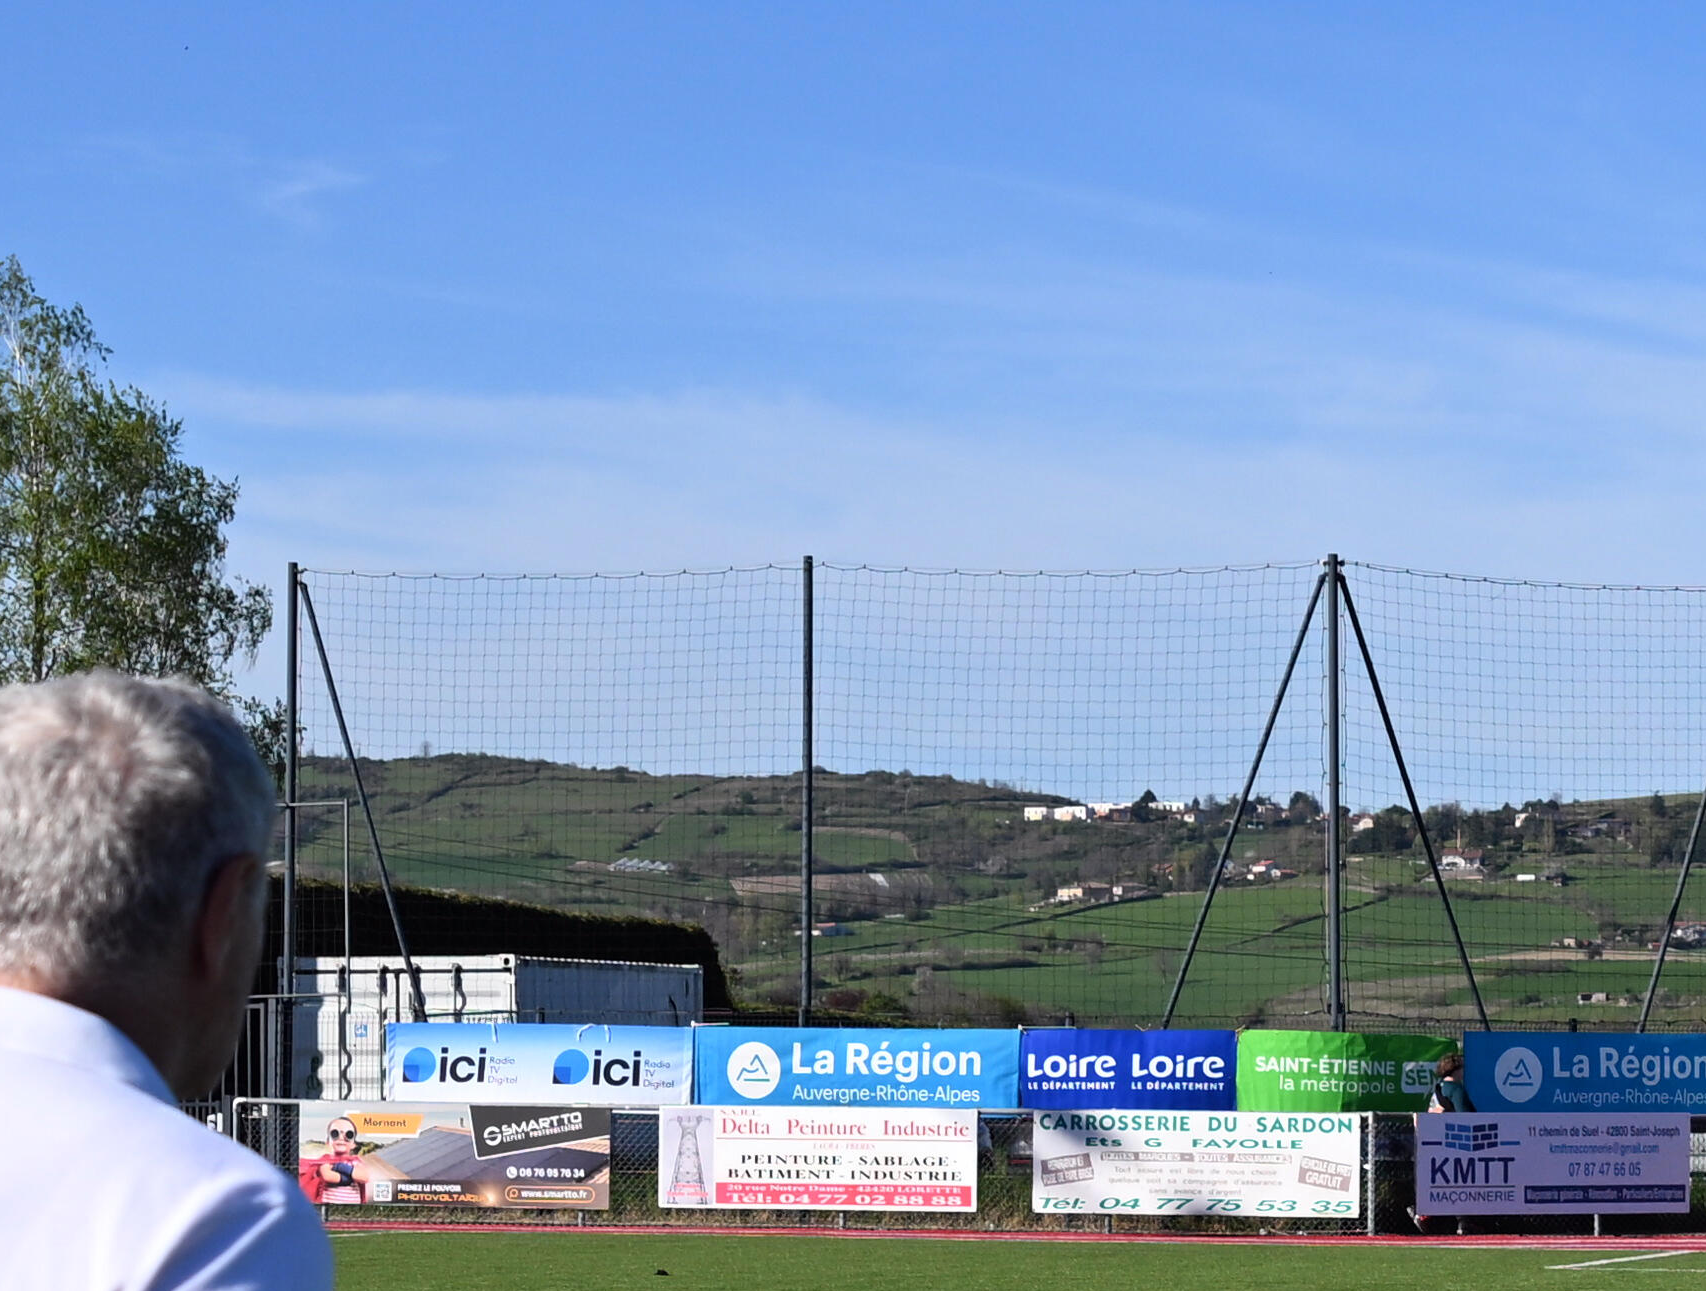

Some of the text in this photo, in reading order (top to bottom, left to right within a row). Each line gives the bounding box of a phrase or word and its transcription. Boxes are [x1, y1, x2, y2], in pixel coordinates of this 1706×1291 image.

[439, 1047, 487, 1083] ici
[489, 1057, 516, 1065] Radio
[592, 1049, 641, 1087] ici
[644, 1060, 671, 1069] Radio
[792, 1042, 981, 1083] La Région
[1027, 1054, 1116, 1078] Loire
[1132, 1054, 1225, 1078] Loire
[1255, 1055, 1395, 1076] SAINT-ÉTIENNE
[1553, 1047, 1589, 1078] La
[489, 1067, 501, 1075] TV
[488, 1075, 518, 1085] Digital
[1043, 1080, 1115, 1090] DÉPARTEMENT
[1146, 1080, 1225, 1091] DÉPARTEMENT
[1279, 1075, 1395, 1096] la métropole
[792, 1084, 980, 1103] Auvergne-Rhône-Alpes
[363, 1118, 407, 1128] Mornant
[501, 1111, 582, 1136] SMARTTO
[722, 1118, 969, 1137] Delta Peinture Industrie
[1039, 1114, 1352, 1133] CARROSSERIE DU SARDON
[1528, 1127, 1680, 1138] 11 chemin de Suel Saint-Joseph
[1085, 1137, 1303, 1149] Ets G FAYOLLE
[741, 1154, 949, 1166] PEINTURE SABLAGE
[519, 1168, 585, 1178] 06 76 34
[728, 1168, 962, 1182] BATIMENT INDUSTRIE
[1430, 1157, 1515, 1185] KMTT
[1569, 1163, 1641, 1177] 07 87 47 66 05
[397, 1184, 461, 1192] PRENEZ POUVOIR
[521, 1189, 587, 1200] www.smartto.fr
[770, 1184, 805, 1192] Notre
[726, 1192, 962, 1206] Tél: 04 77 02 88 88
[1039, 1197, 1354, 1213] Tél: 04 77 75 53 35
[1430, 1191, 1515, 1205] MAÇONNERIE
